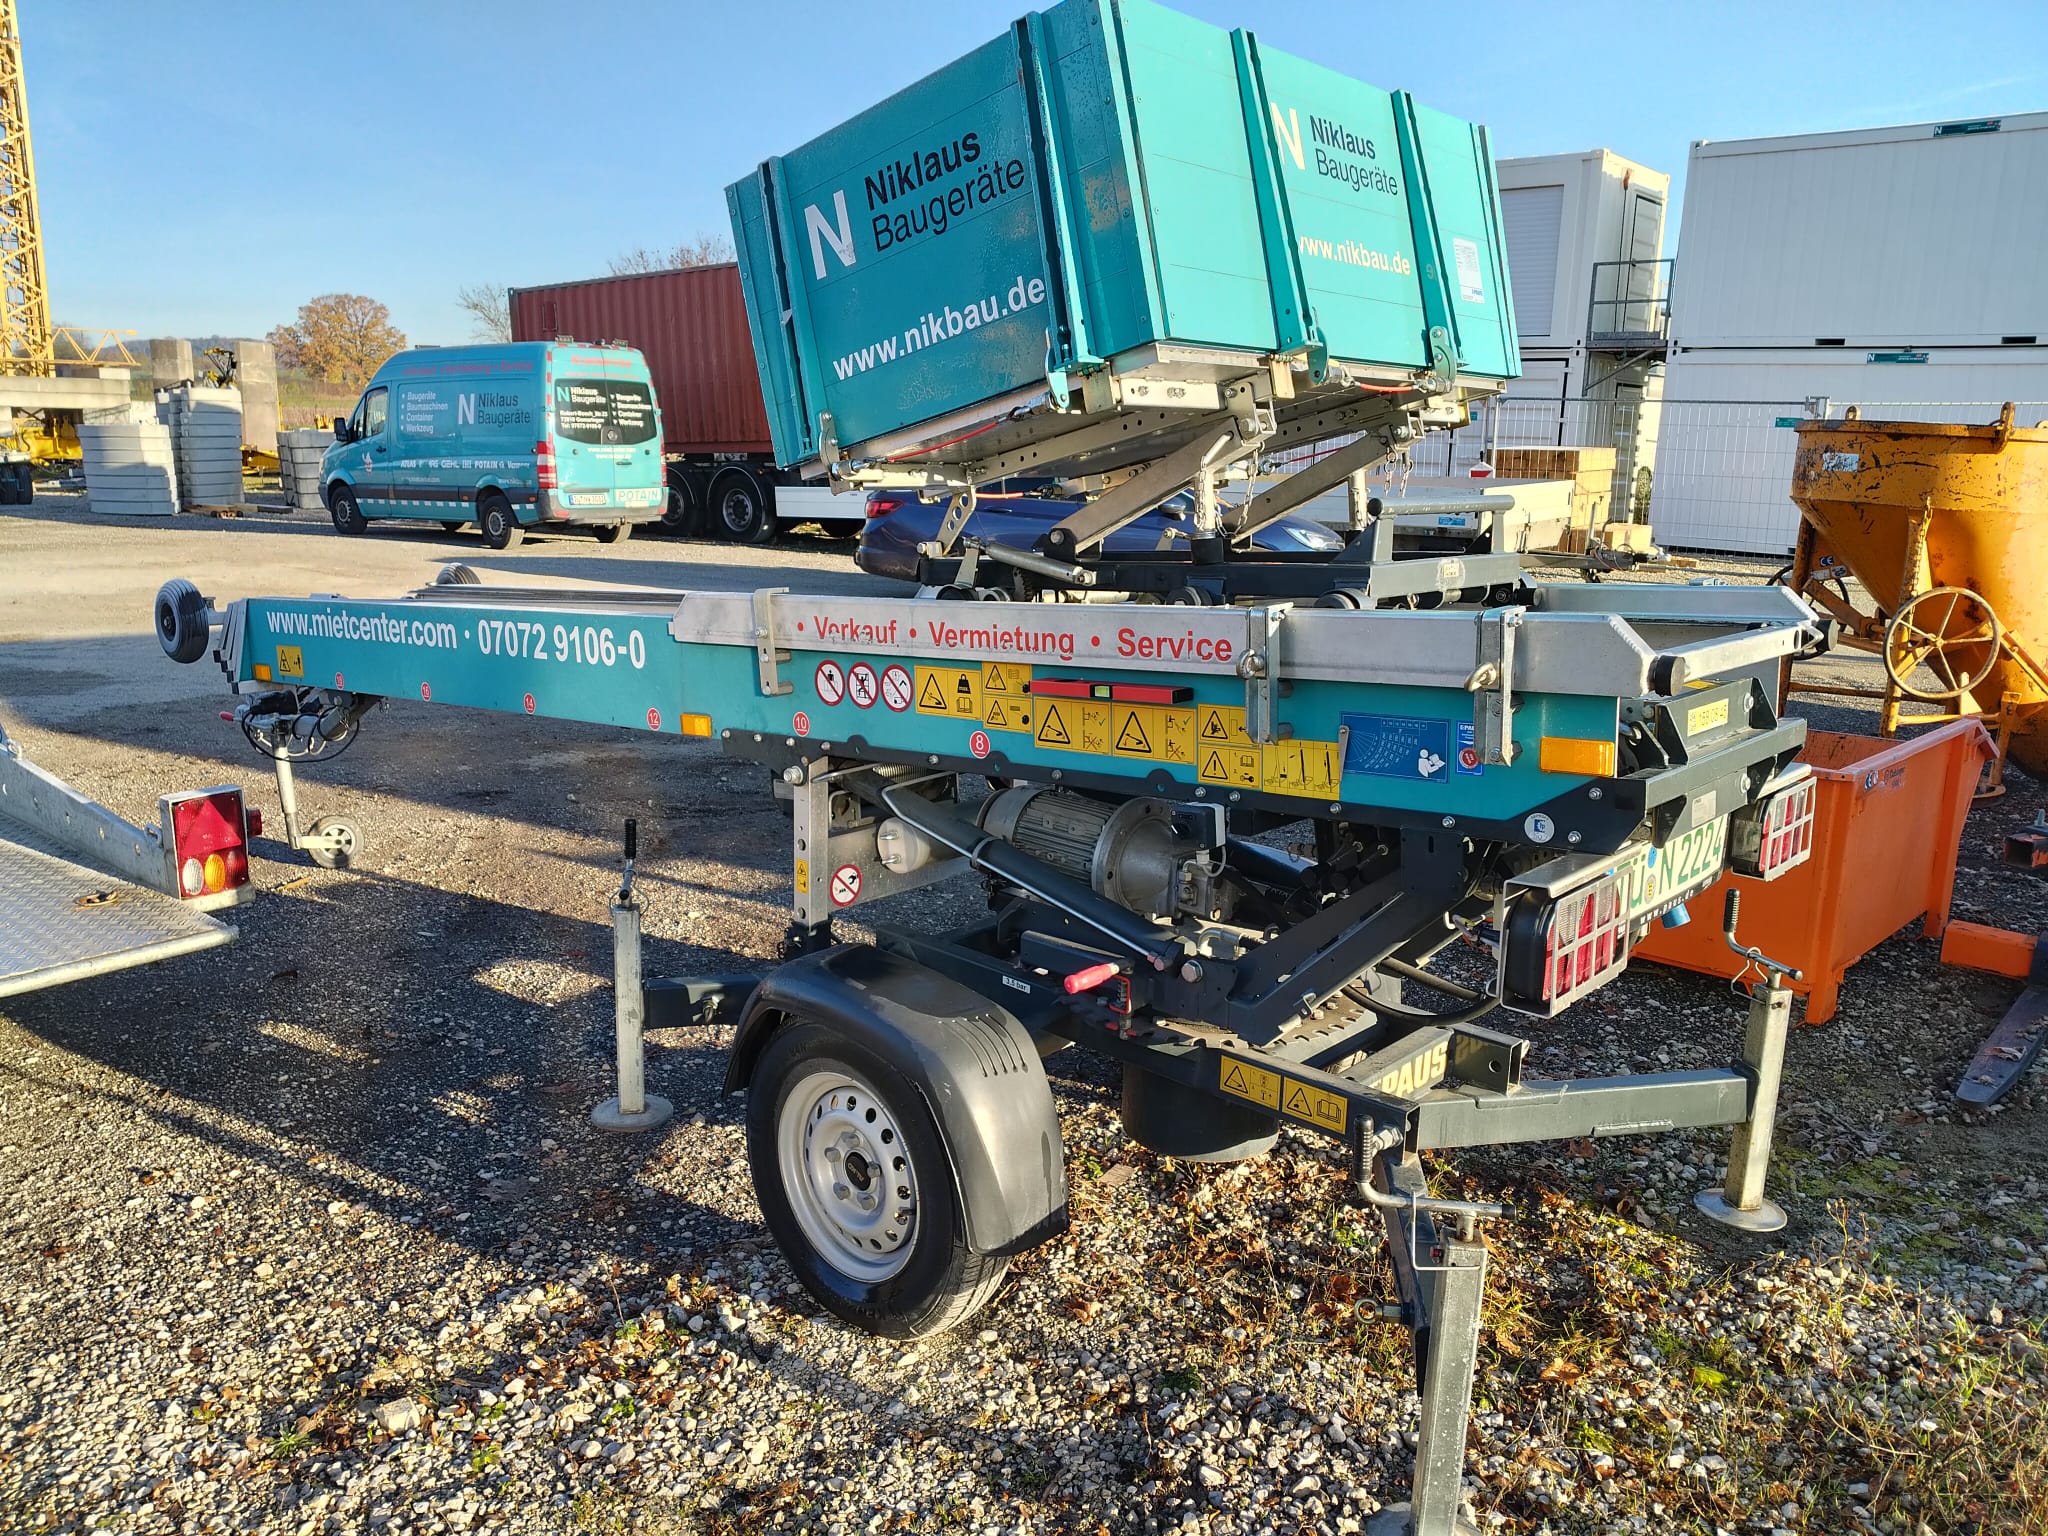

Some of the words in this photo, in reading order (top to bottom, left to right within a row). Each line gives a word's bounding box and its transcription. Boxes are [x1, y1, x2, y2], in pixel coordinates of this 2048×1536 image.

[1270, 102, 1306, 171] N
[1309, 115, 1376, 160] Niklaus
[864, 132, 981, 212] Niklaus
[1315, 148, 1398, 196] Baugeräte
[871, 159, 1025, 252] Baugeräte
[803, 189, 856, 280] N
[833, 275, 1047, 380] www.nikbau.de
[406, 401, 448, 411] Baumaschinen
[407, 391, 436, 402] Baugeräte
[478, 393, 519, 407] Niklaus
[556, 386, 571, 402] N
[406, 412, 434, 422] Container
[458, 393, 475, 425] N
[478, 409, 531, 427] Baugeräte
[406, 424, 434, 434] Werkzeug
[618, 490, 659, 501] POTAIN
[266, 607, 458, 649] www.mietcenter.com
[477, 618, 549, 660] 07072
[553, 624, 647, 669] 9106-0
[813, 615, 898, 646] Verkauf
[928, 621, 1075, 661] Vermietung
[1117, 628, 1233, 662] Service
[525, 696, 534, 708] 14
[648, 712, 658, 724] 12
[795, 717, 807, 729] 10
[975, 735, 984, 751] 8
[1659, 838, 1677, 895] N
[1677, 815, 1725, 886] 2224
[1382, 1040, 1449, 1097] PAUS
